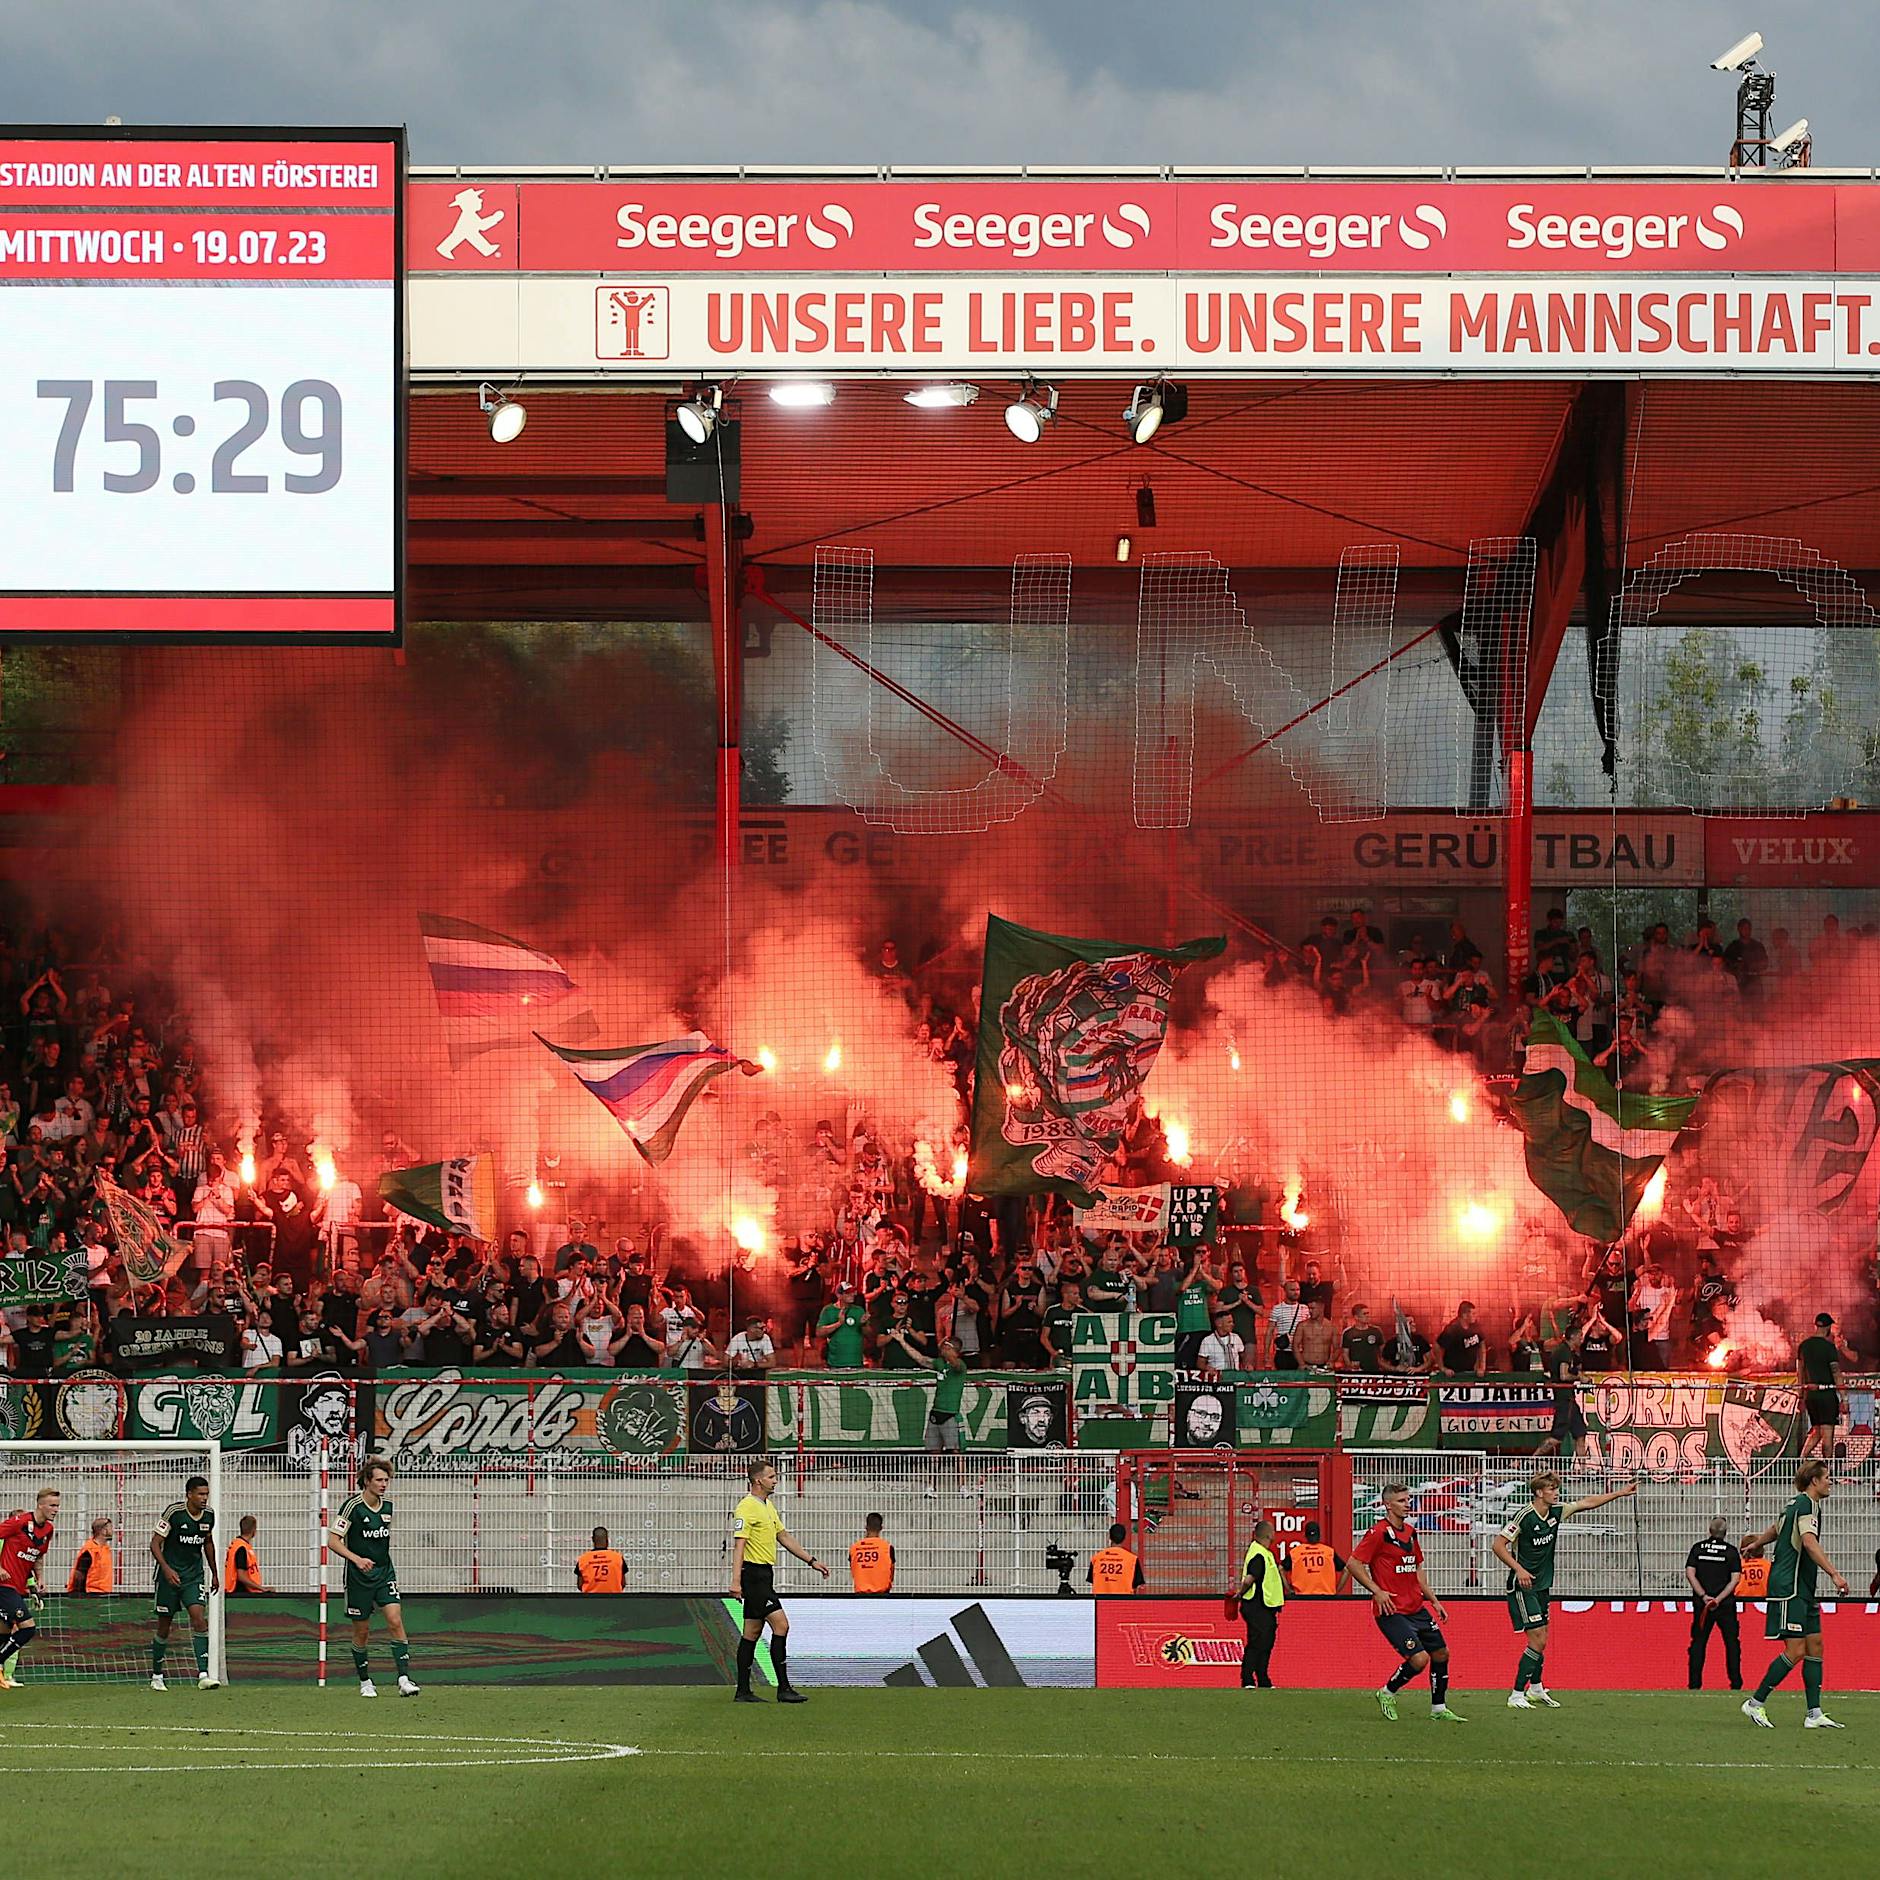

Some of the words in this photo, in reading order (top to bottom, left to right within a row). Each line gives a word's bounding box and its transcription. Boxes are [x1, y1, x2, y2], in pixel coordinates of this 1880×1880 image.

[0, 163, 95, 188] STADION
[101, 165, 132, 188] AN
[138, 164, 181, 188] DER
[187, 164, 256, 188] ALTEN
[262, 159, 378, 189] FÖRSTEREI
[616, 203, 797, 258] Seeger
[913, 203, 1094, 258] Seeger
[1209, 204, 1391, 259] Seeger
[1506, 204, 1688, 259] Seeger
[0, 230, 164, 264] MITTWOCH
[191, 230, 327, 265] 19.07.23
[707, 292, 943, 353] UNSERE
[968, 292, 1155, 353] LIEBE.
[1185, 292, 1422, 353] UNSERE
[1449, 292, 1880, 354] MANNSCHAFT.
[37, 379, 343, 495] 75:29
[1353, 824, 1676, 871] GERÜTBAU
[1731, 838, 1854, 865] VELUX
[1023, 1122, 1077, 1139] 1988
[1172, 1201, 1212, 1214] ADT
[1173, 1188, 1212, 1201] UPT
[1576, 1376, 1709, 1428] ORN
[1272, 1511, 1306, 1532] Tor
[593, 1565, 609, 1577] 75
[856, 1551, 879, 1562] 259
[1100, 1563, 1123, 1574] 282
[1302, 1556, 1324, 1567] 110
